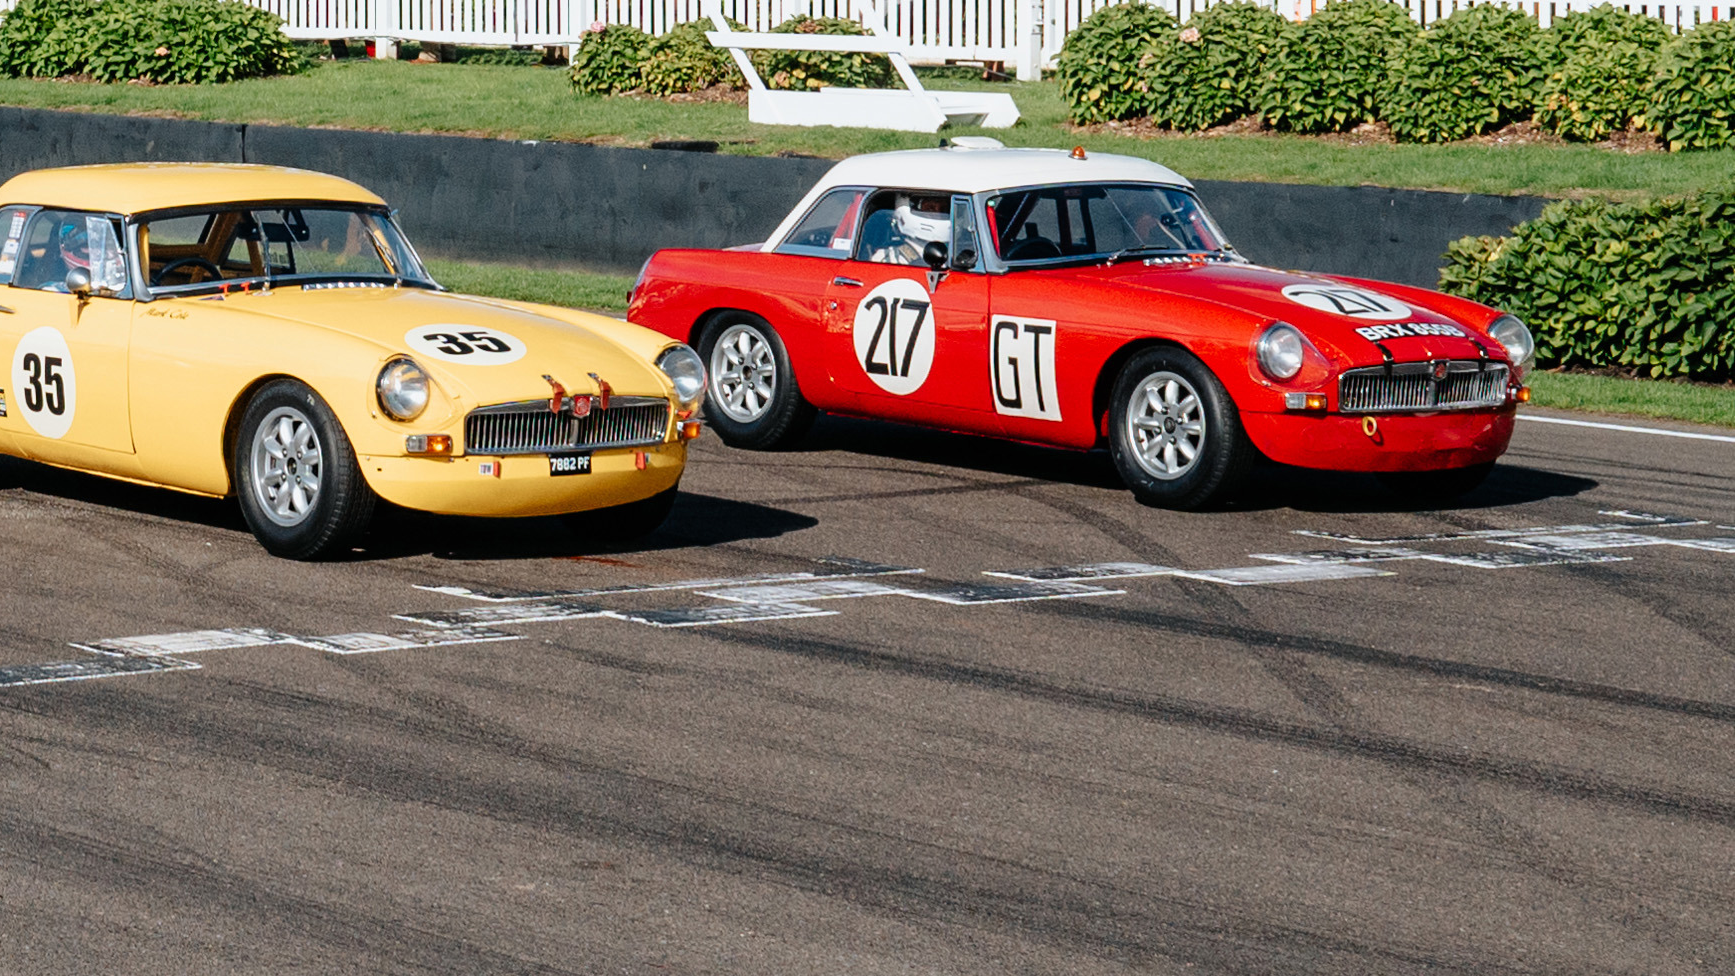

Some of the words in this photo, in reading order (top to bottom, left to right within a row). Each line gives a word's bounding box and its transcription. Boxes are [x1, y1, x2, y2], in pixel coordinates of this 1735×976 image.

[1288, 288, 1392, 315] 217
[422, 331, 512, 356] 35
[864, 296, 930, 377] 217
[1355, 323, 1416, 341] BRX
[1407, 323, 1466, 337] 855B
[993, 321, 1053, 413] GT
[23, 352, 66, 416] 35
[549, 457, 577, 471] 7882
[577, 456, 591, 470] PF
